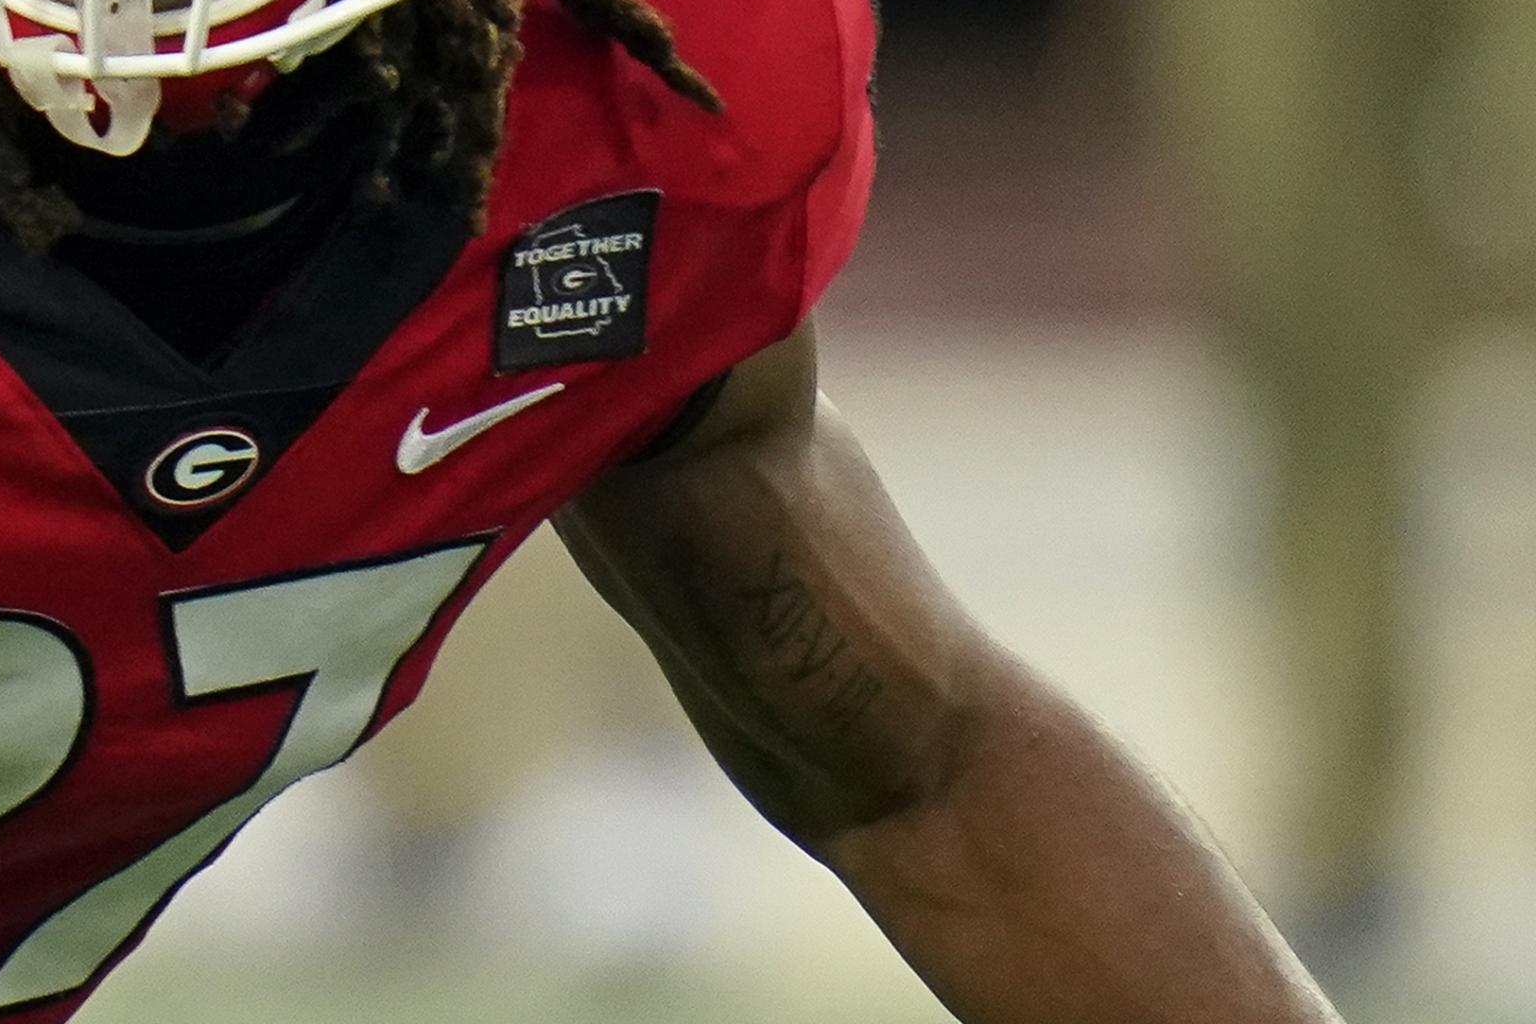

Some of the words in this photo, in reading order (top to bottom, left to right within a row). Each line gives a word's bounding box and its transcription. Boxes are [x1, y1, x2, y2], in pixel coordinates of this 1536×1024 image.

[514, 233, 644, 267] TOGETHER
[507, 294, 632, 328] EQUALITY
[173, 442, 258, 490] G
